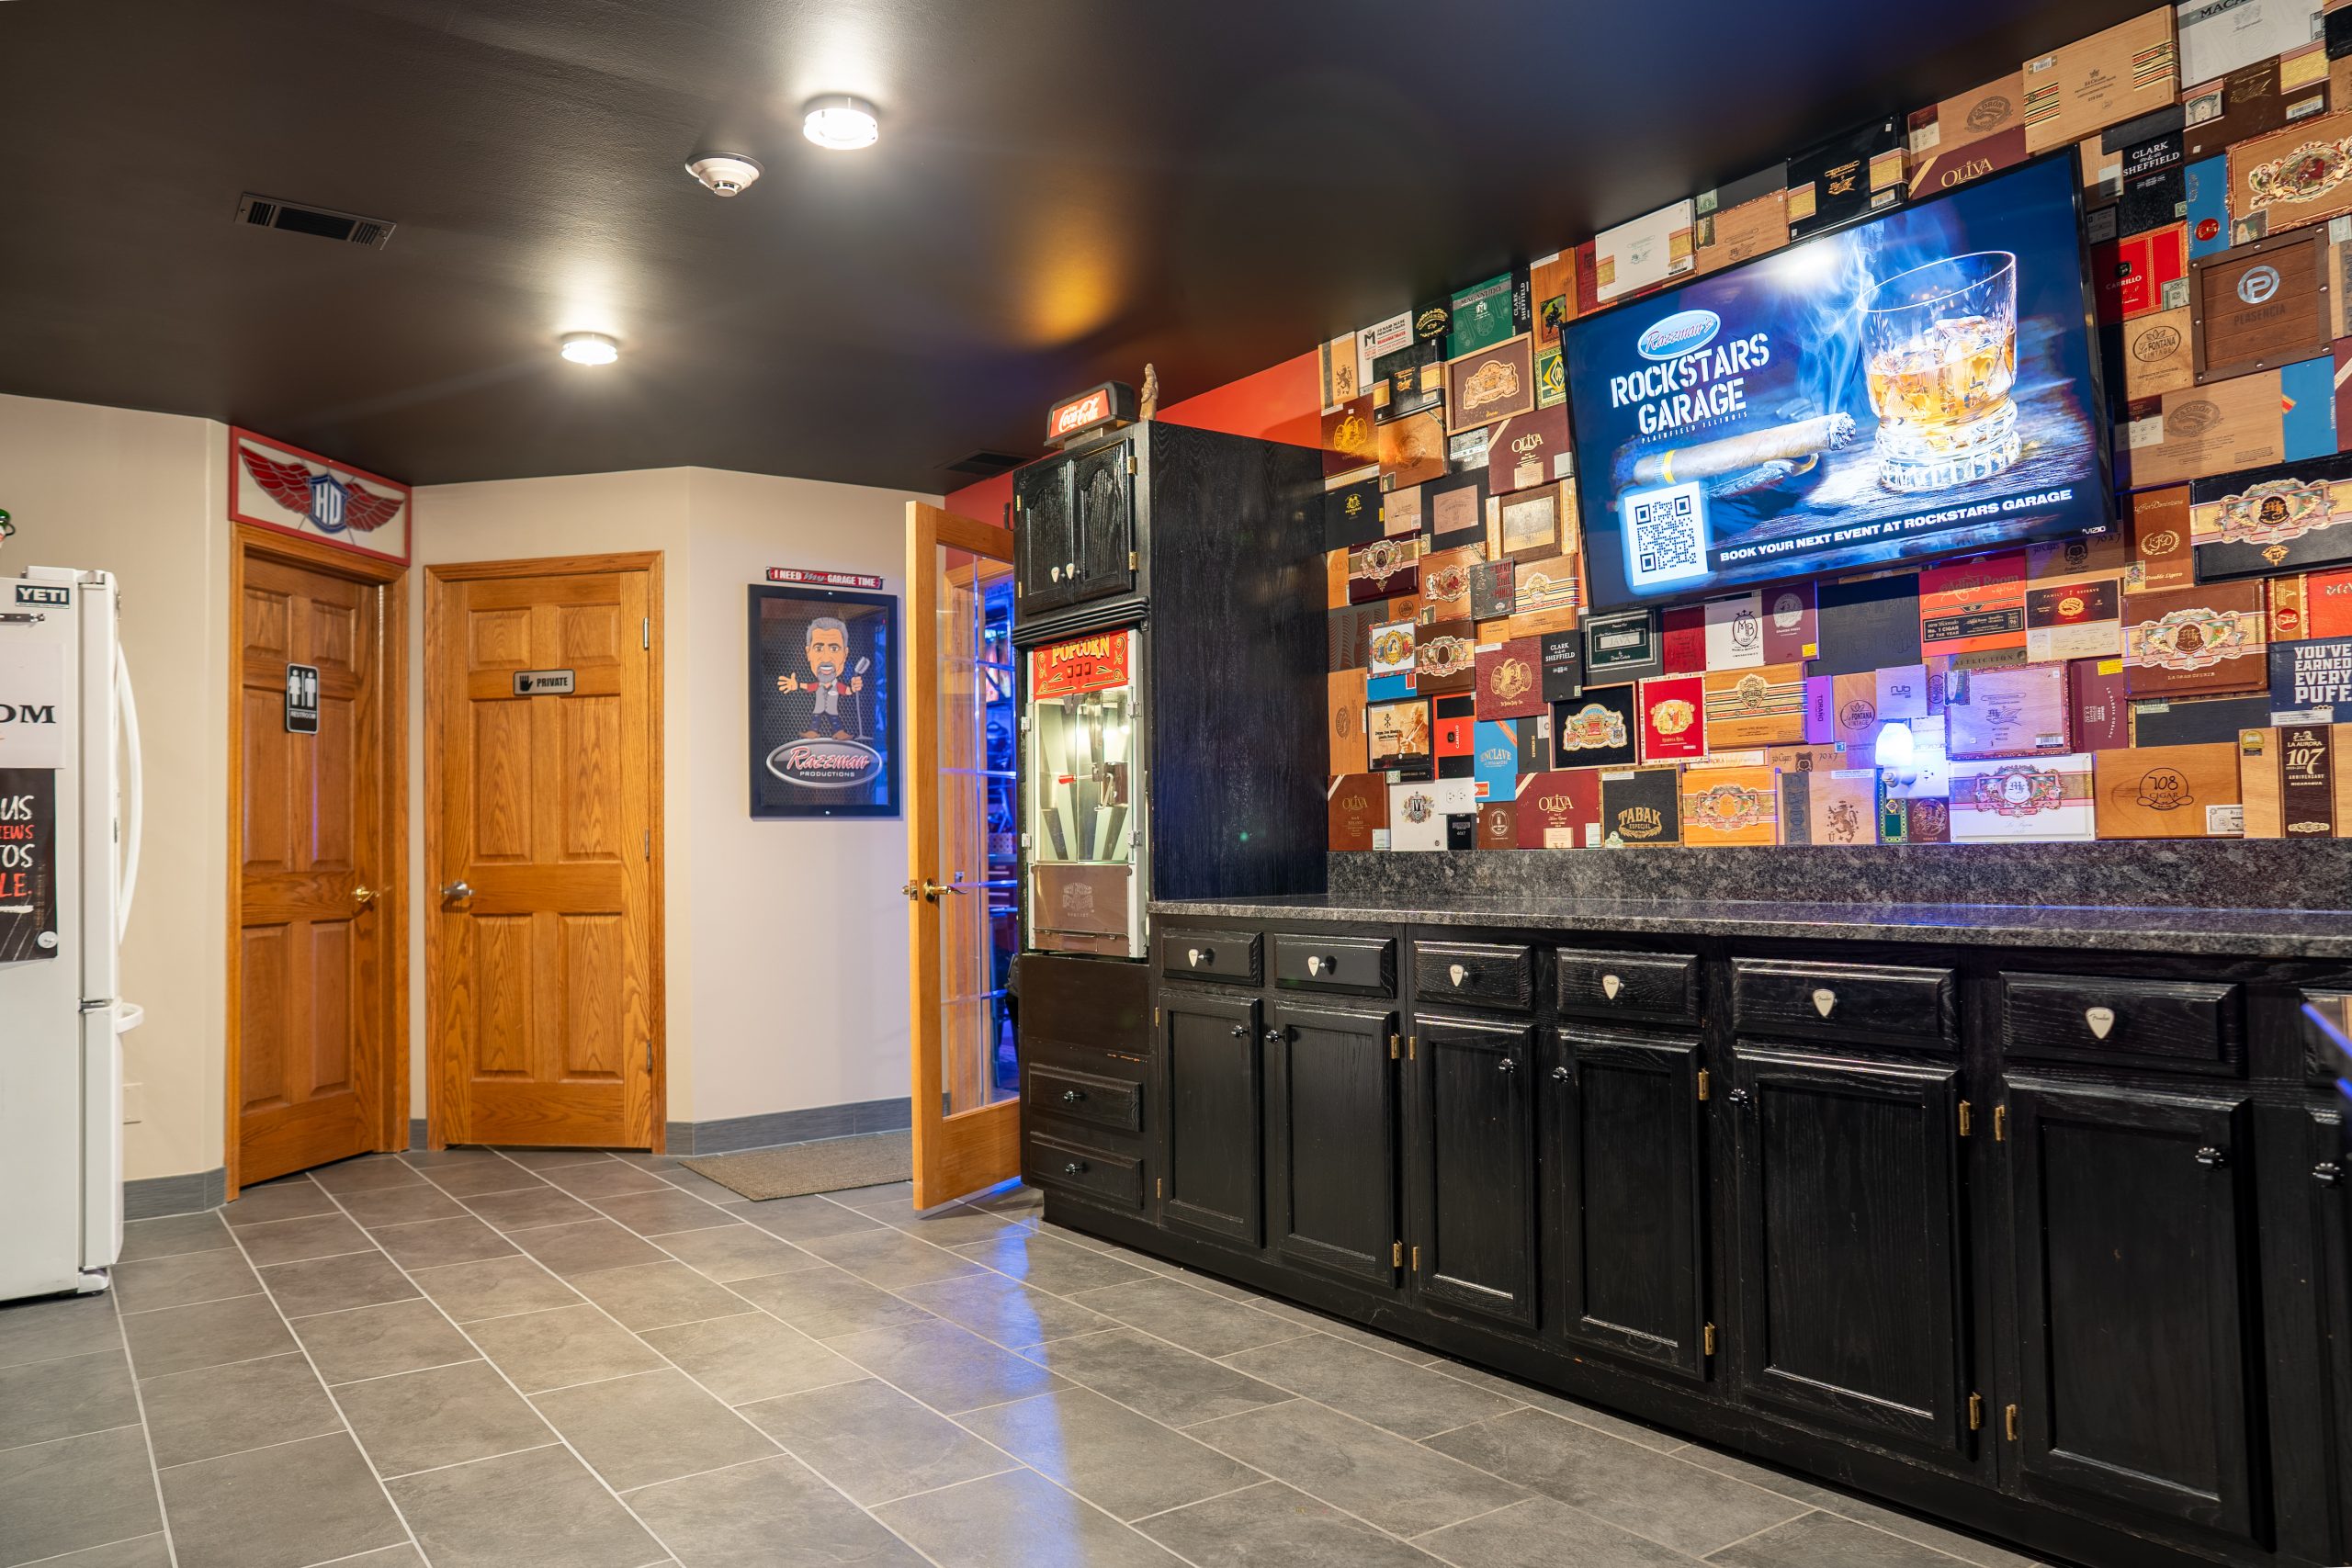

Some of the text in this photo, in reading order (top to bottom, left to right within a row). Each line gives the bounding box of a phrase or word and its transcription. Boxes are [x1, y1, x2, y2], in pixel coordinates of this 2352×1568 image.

[2132, 141, 2168, 160] CLARK
[1940, 157, 1994, 187] OLIVA
[2123, 152, 2180, 176] SHEFFIELD
[2105, 275, 2142, 290] CARRILLO
[2233, 304, 2286, 326] PLASENCIA
[2148, 335, 2177, 351] FONTANA
[2143, 347, 2172, 360] VINTAGE
[1611, 333, 1770, 408] ROCKSTARS
[1638, 378, 1746, 434] GARAGE
[1641, 411, 1747, 444] PLAINFIELD ILLINOIS
[1511, 434, 1544, 454] OLIVA
[315, 482, 341, 525] HD
[1720, 489, 2073, 562] BOOK YOUR NEXT EVENT AT ROCKSTARS GARAGE
[775, 568, 778, 579] I
[779, 569, 801, 580] NEED
[828, 574, 855, 585] GARAGE
[857, 576, 876, 586] TIME
[17, 587, 67, 603] YETI
[1052, 634, 1111, 668] POPCORN
[1545, 651, 1575, 662] SHEFFIELD
[2294, 644, 2352, 660] YOU'VE
[2295, 658, 2352, 671] EARNED
[537, 677, 568, 687] PRIVATE
[2295, 670, 2352, 686] EVERY
[2295, 684, 2352, 704] PUFF.
[289, 711, 317, 719] RESTROOM
[1851, 712, 1872, 720] FONTANA
[786, 746, 870, 771] Razzman
[2286, 748, 2325, 774] 107
[2149, 776, 2178, 791] 708
[1342, 795, 1367, 811] OLIVA
[1538, 794, 1574, 814] OLIVA
[1618, 807, 1661, 823] TABAK
